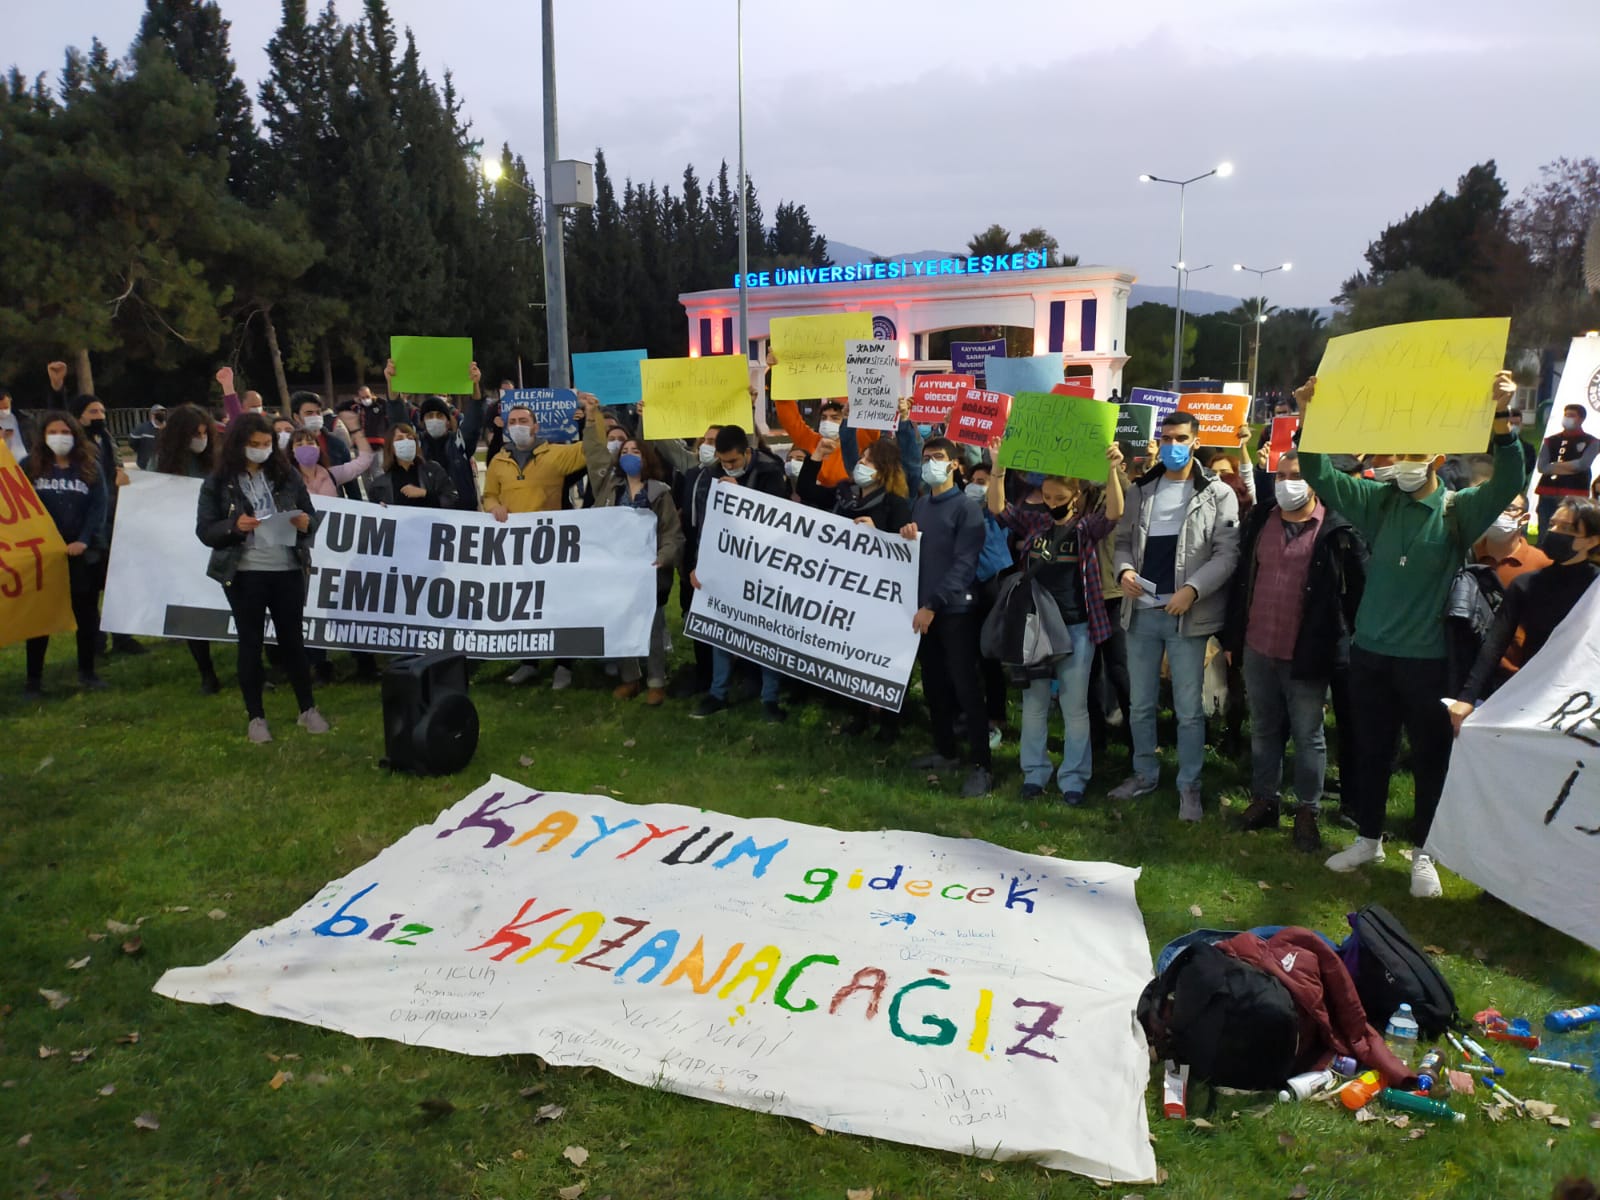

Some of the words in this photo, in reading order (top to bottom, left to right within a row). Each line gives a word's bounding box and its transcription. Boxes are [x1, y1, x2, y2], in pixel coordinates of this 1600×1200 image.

[775, 258, 907, 287] ÜNİVERSİTESİ
[913, 247, 1048, 276] YERLEŞKESİ
[966, 389, 981, 401] HER
[982, 392, 999, 403] YER
[1187, 401, 1233, 410] KAYYUMLAR
[959, 415, 976, 427] HER
[976, 419, 993, 430] YER
[428, 518, 581, 566] REKTÖR
[713, 490, 816, 538] FERMAN
[818, 523, 913, 564] SARAYIN
[717, 528, 904, 604] ÜNİVERSİTELER
[742, 578, 857, 632] BİZİMDİR!
[324, 619, 444, 650] ÜNİVERSİTESİ
[453, 629, 555, 653] ÖĞRENCİLERİ
[707, 595, 892, 669] #KayyumRektörİstemiyoruz
[688, 616, 724, 641] İZMİR
[724, 628, 797, 670] ÜNİVERSİTE
[796, 657, 901, 705] DAYANIŞMASI
[435, 791, 790, 879] KAYYUM
[784, 864, 1038, 913] gidecek
[311, 883, 434, 945] biz
[464, 897, 1065, 1062] KAZANACAĞIZ
